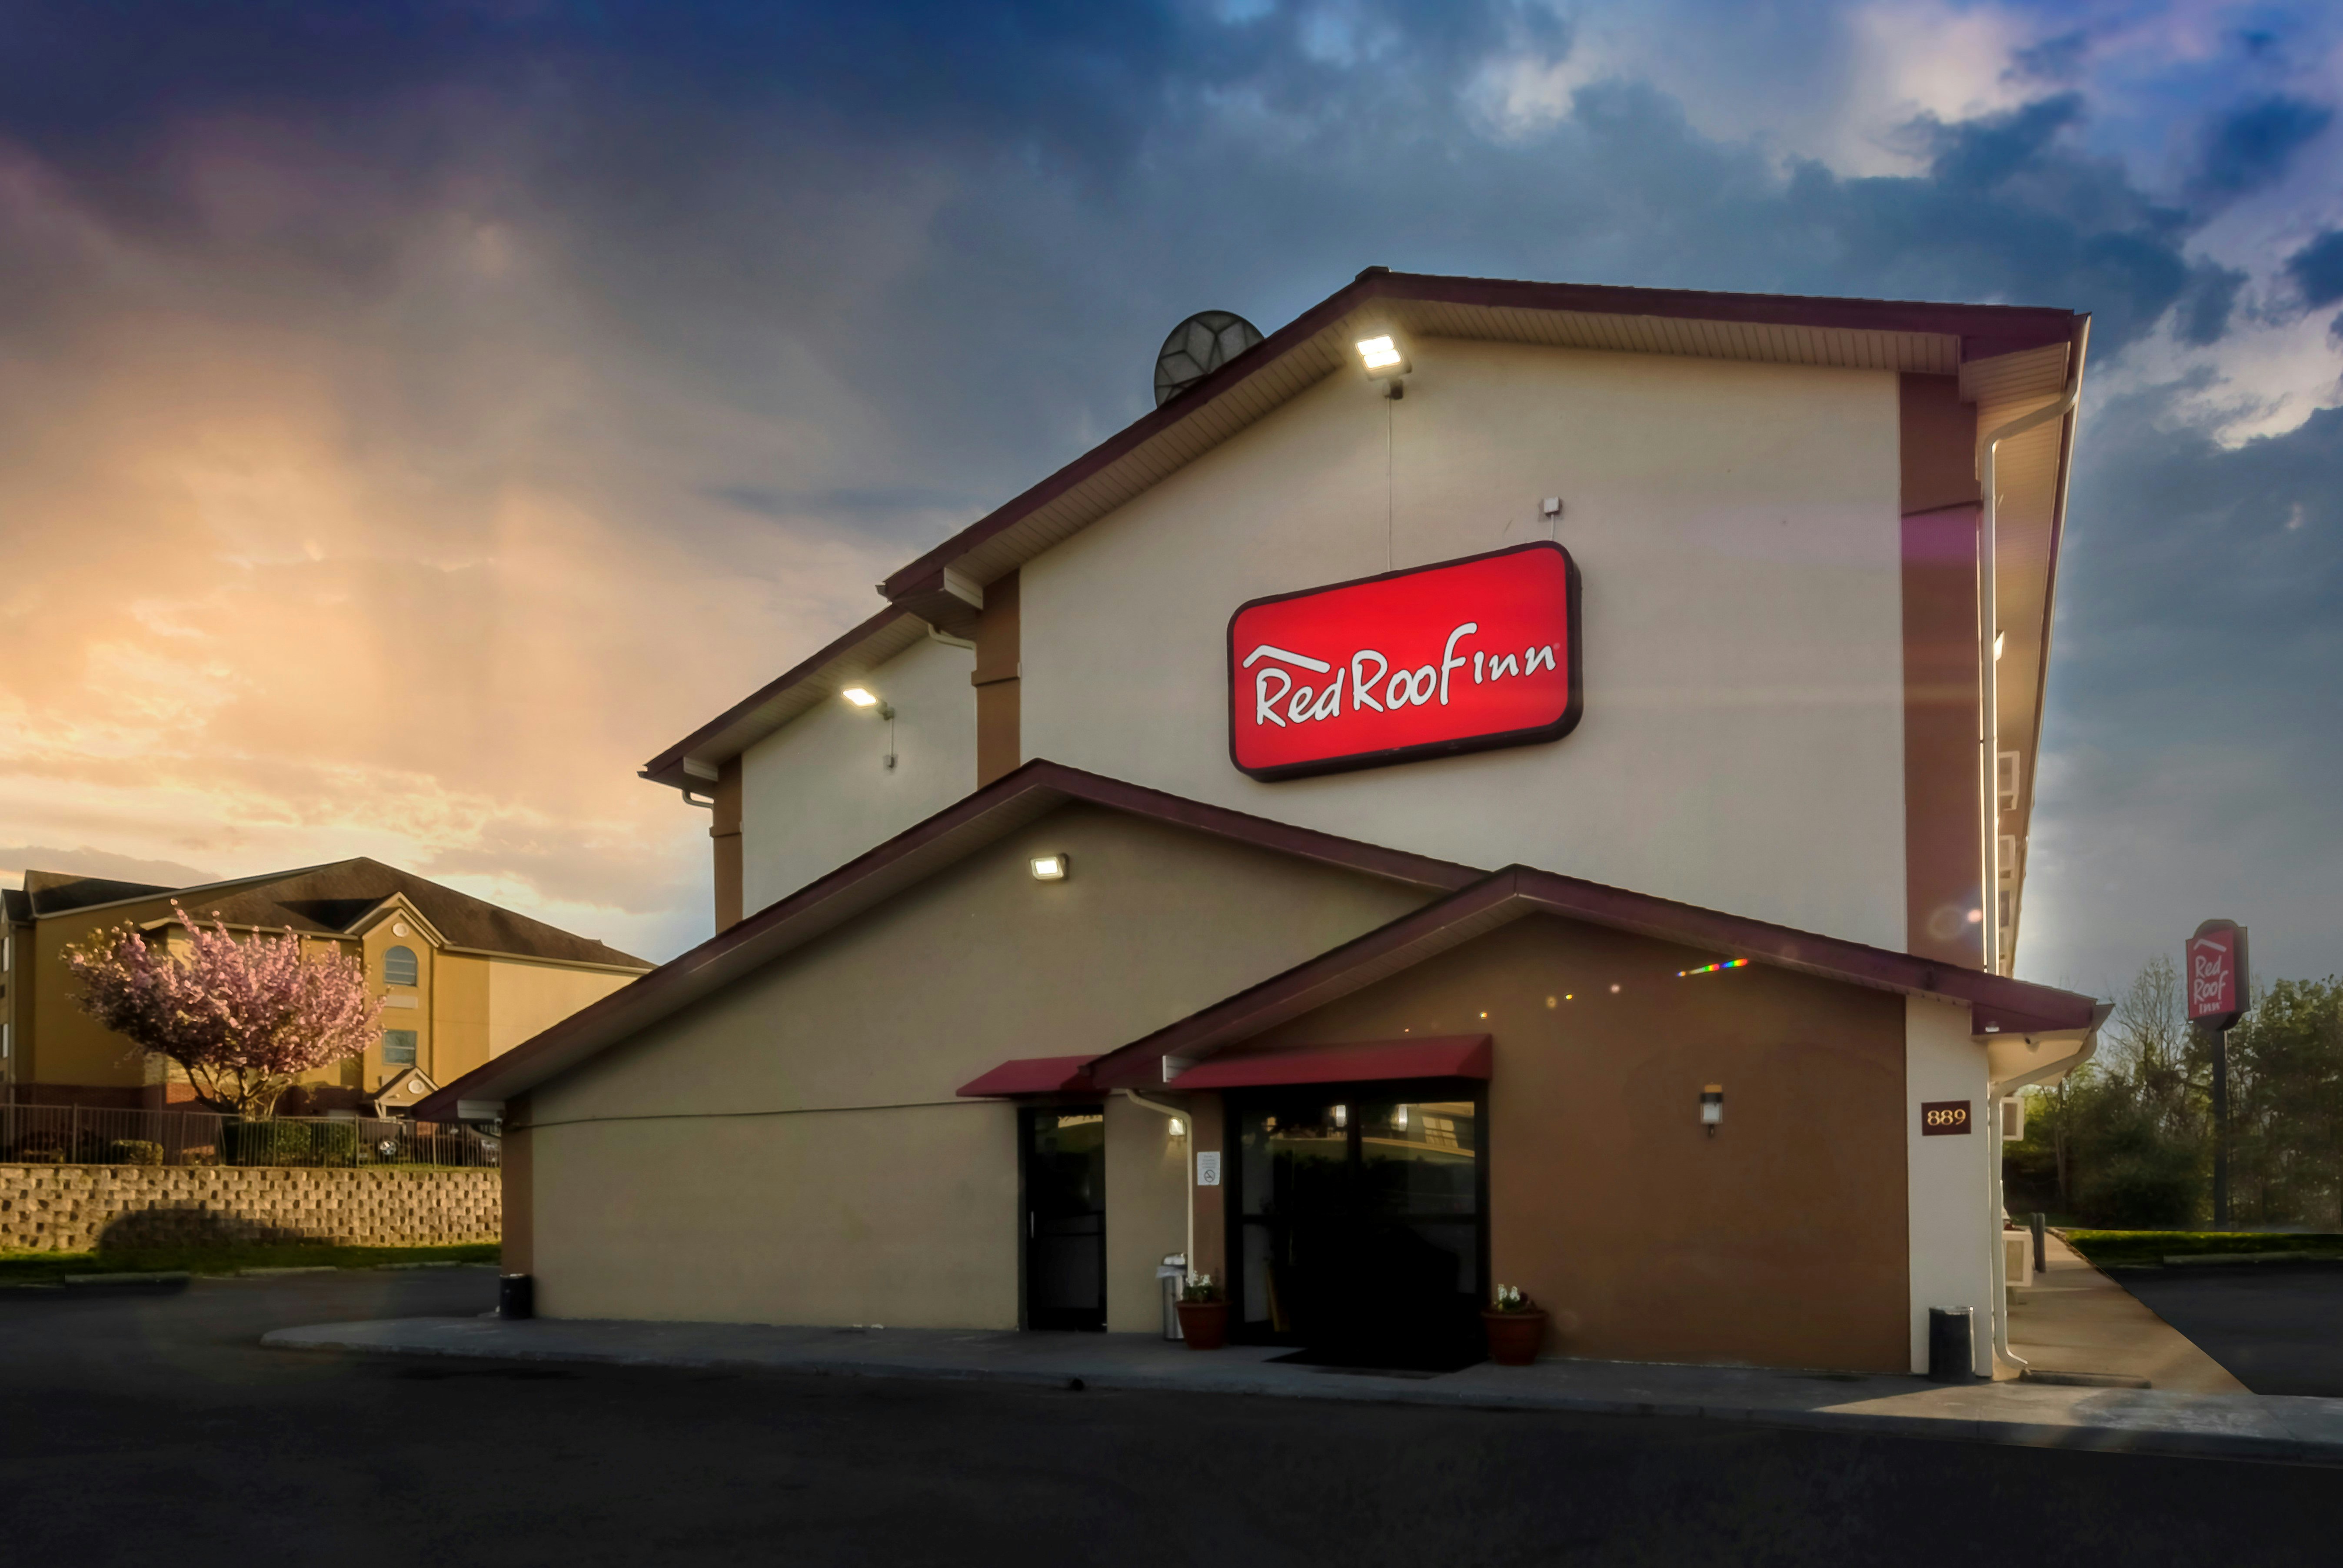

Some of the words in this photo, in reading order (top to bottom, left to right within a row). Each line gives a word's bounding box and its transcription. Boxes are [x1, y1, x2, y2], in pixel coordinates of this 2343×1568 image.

[2195, 955, 2222, 978] Red
[2193, 970, 2229, 1005] Roof
[1927, 1109, 1966, 1126] 889
